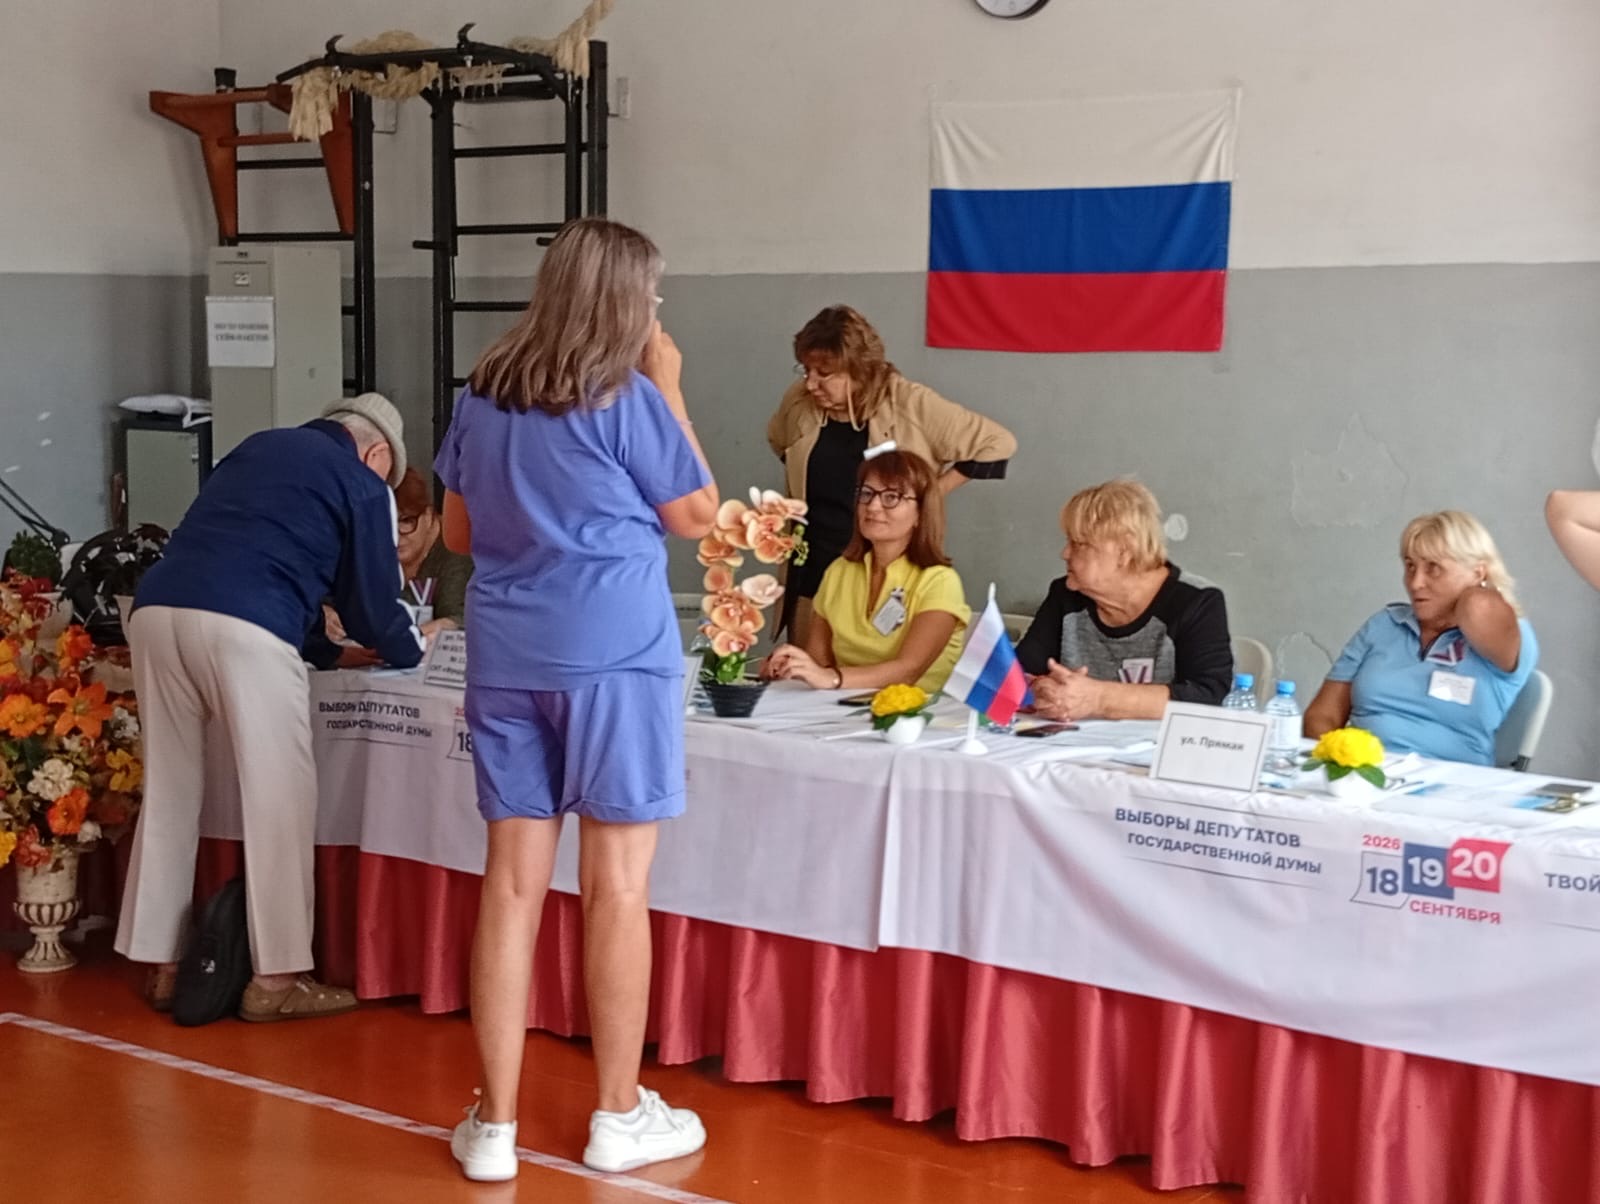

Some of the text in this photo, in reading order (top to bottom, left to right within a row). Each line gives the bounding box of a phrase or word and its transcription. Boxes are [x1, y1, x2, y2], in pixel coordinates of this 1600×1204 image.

[1180, 736, 1197, 746] ул.
[1115, 808, 1301, 848] ВЫБОРЫ ДЕПУТАТОВ
[1127, 832, 1322, 875] ГОСУДАРСТВЕННОЙ ДУМЫ
[1362, 834, 1401, 850] 2026
[1366, 847, 1499, 896] 18 19 20
[1544, 871, 1600, 893] ТВОЙ
[1409, 899, 1501, 925] СЕНТЯБРЯ
